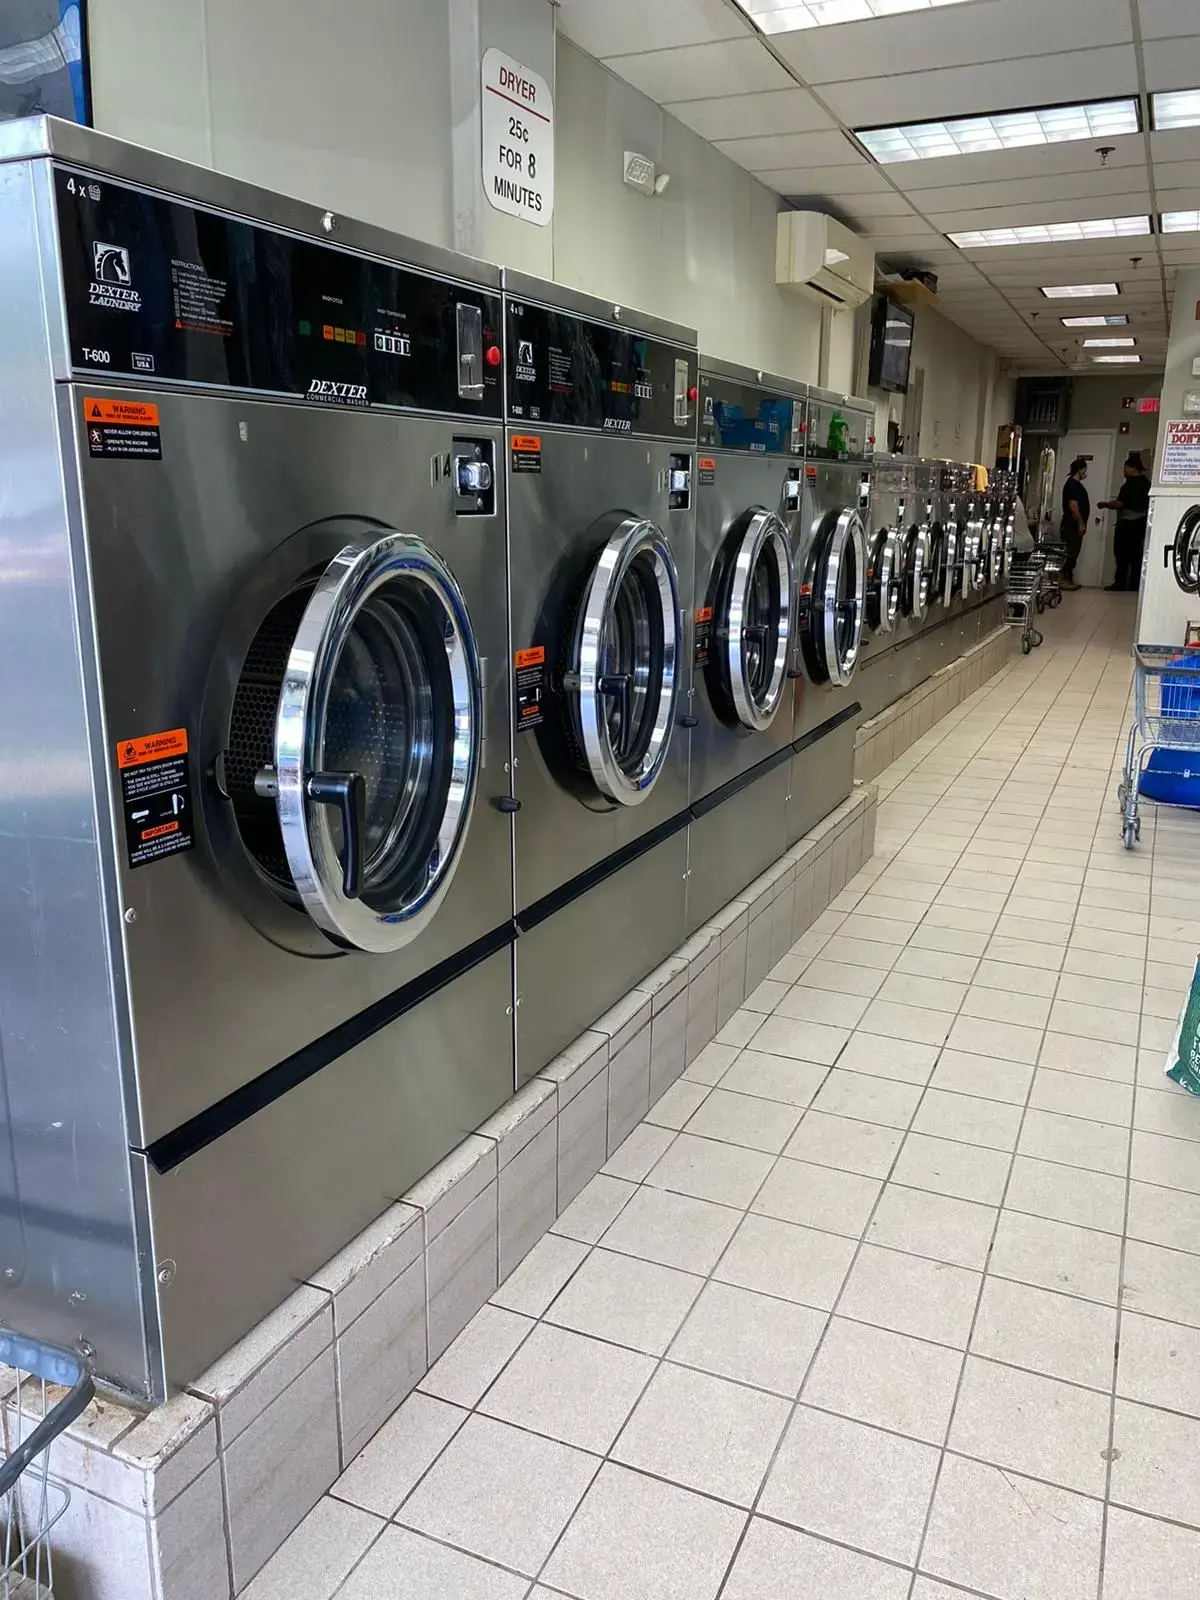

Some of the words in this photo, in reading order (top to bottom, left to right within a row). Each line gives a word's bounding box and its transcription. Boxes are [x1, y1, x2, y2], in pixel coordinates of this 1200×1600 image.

[499, 67, 536, 102] DRYER
[508, 117, 529, 143] 25¢
[499, 144, 522, 172] FOR
[528, 153, 536, 179] 8
[66, 177, 76, 195] 4
[494, 175, 542, 212] MINUTES
[88, 282, 140, 301] DEXTER
[88, 294, 142, 312] LAUNDRY
[82, 347, 110, 363] T-600
[136, 361, 150, 369] USA
[308, 379, 367, 399] DEXTER
[306, 393, 345, 404] COMMERCIAL
[346, 398, 370, 407] WASHER
[112, 405, 146, 415] WARNING
[603, 417, 631, 430] DEXTER
[434, 453, 451, 481] 14
[144, 736, 177, 749] WARNING
[143, 823, 177, 837] IMPORTANT
